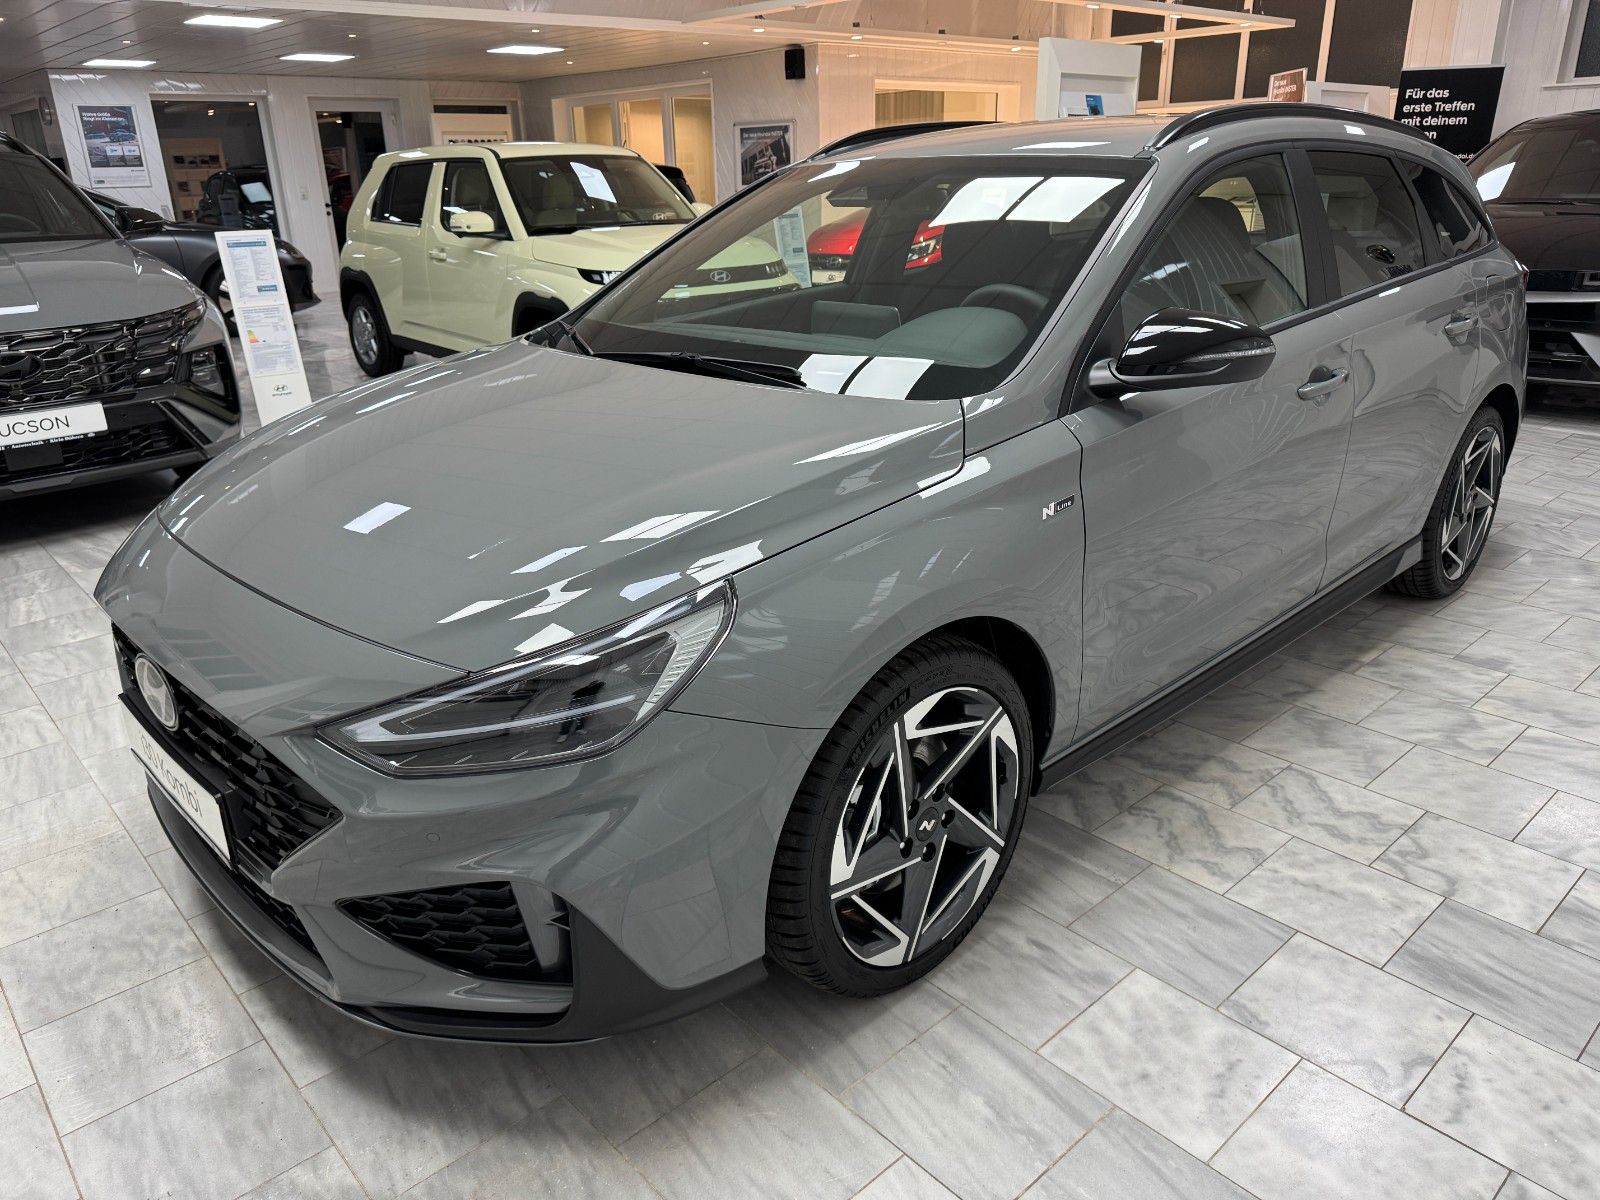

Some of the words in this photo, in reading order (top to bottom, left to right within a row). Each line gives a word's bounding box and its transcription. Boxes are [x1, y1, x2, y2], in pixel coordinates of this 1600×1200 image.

[1405, 88, 1425, 99] Für
[1427, 88, 1450, 98] das
[1402, 102, 1432, 113] erste
[1434, 101, 1475, 112] Treffen
[1401, 116, 1421, 126] mit
[1423, 115, 1468, 126] deinem
[0, 415, 70, 437] UCSON
[138, 730, 159, 769] 30
